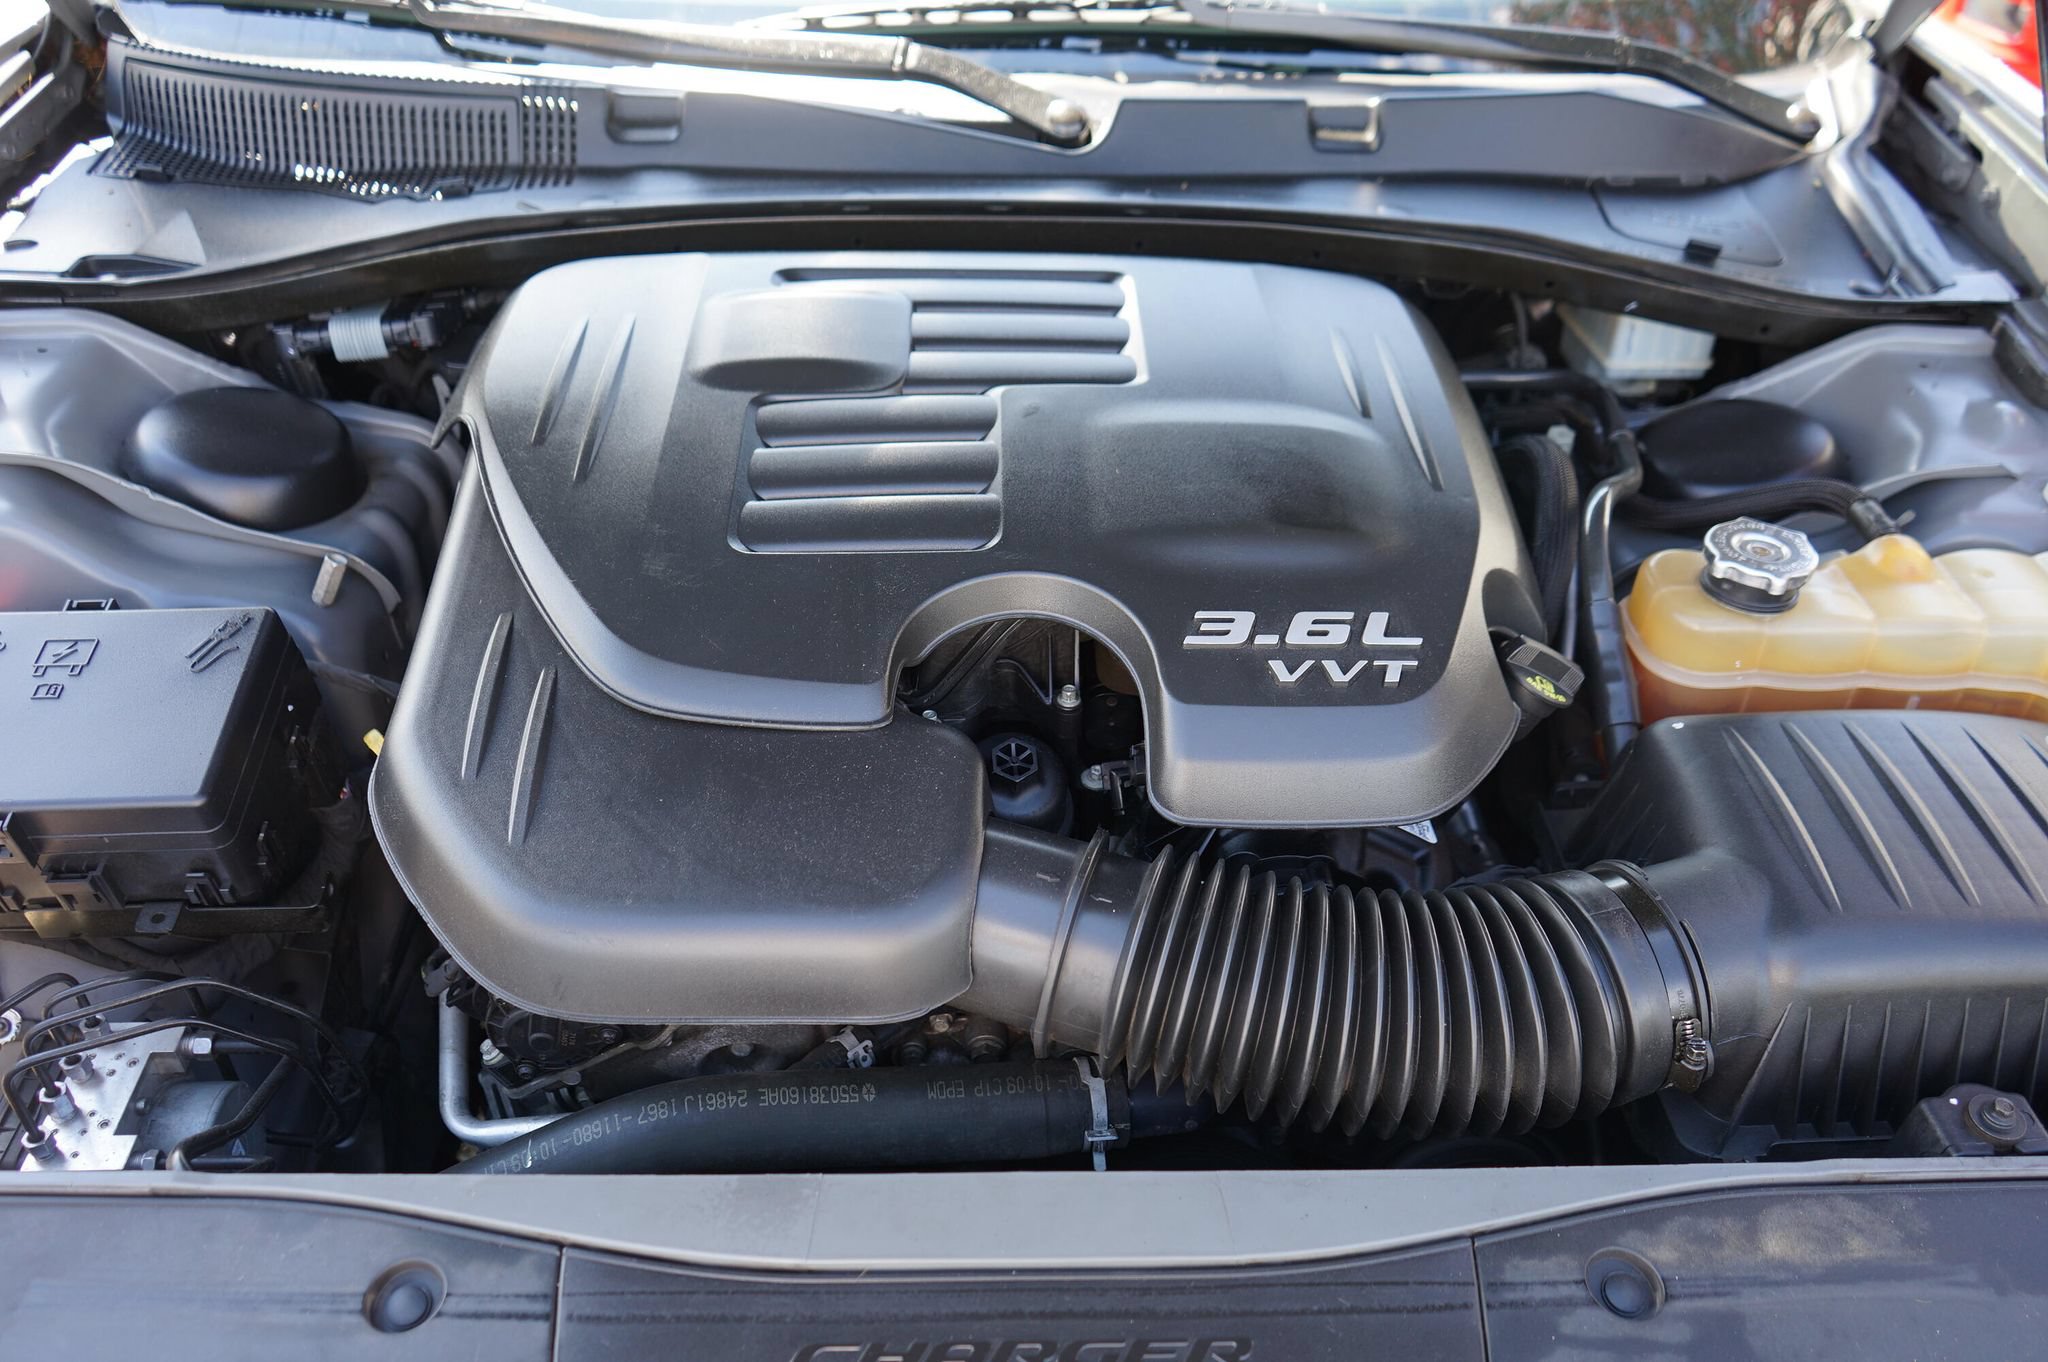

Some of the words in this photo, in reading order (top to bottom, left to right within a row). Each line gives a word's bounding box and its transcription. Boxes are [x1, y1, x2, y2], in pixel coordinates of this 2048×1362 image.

[1183, 611, 1424, 649] 3.6L
[1267, 659, 1418, 686] VVT
[758, 1084, 860, 1107] 55038160AE
[926, 1079, 966, 1100] EPDM
